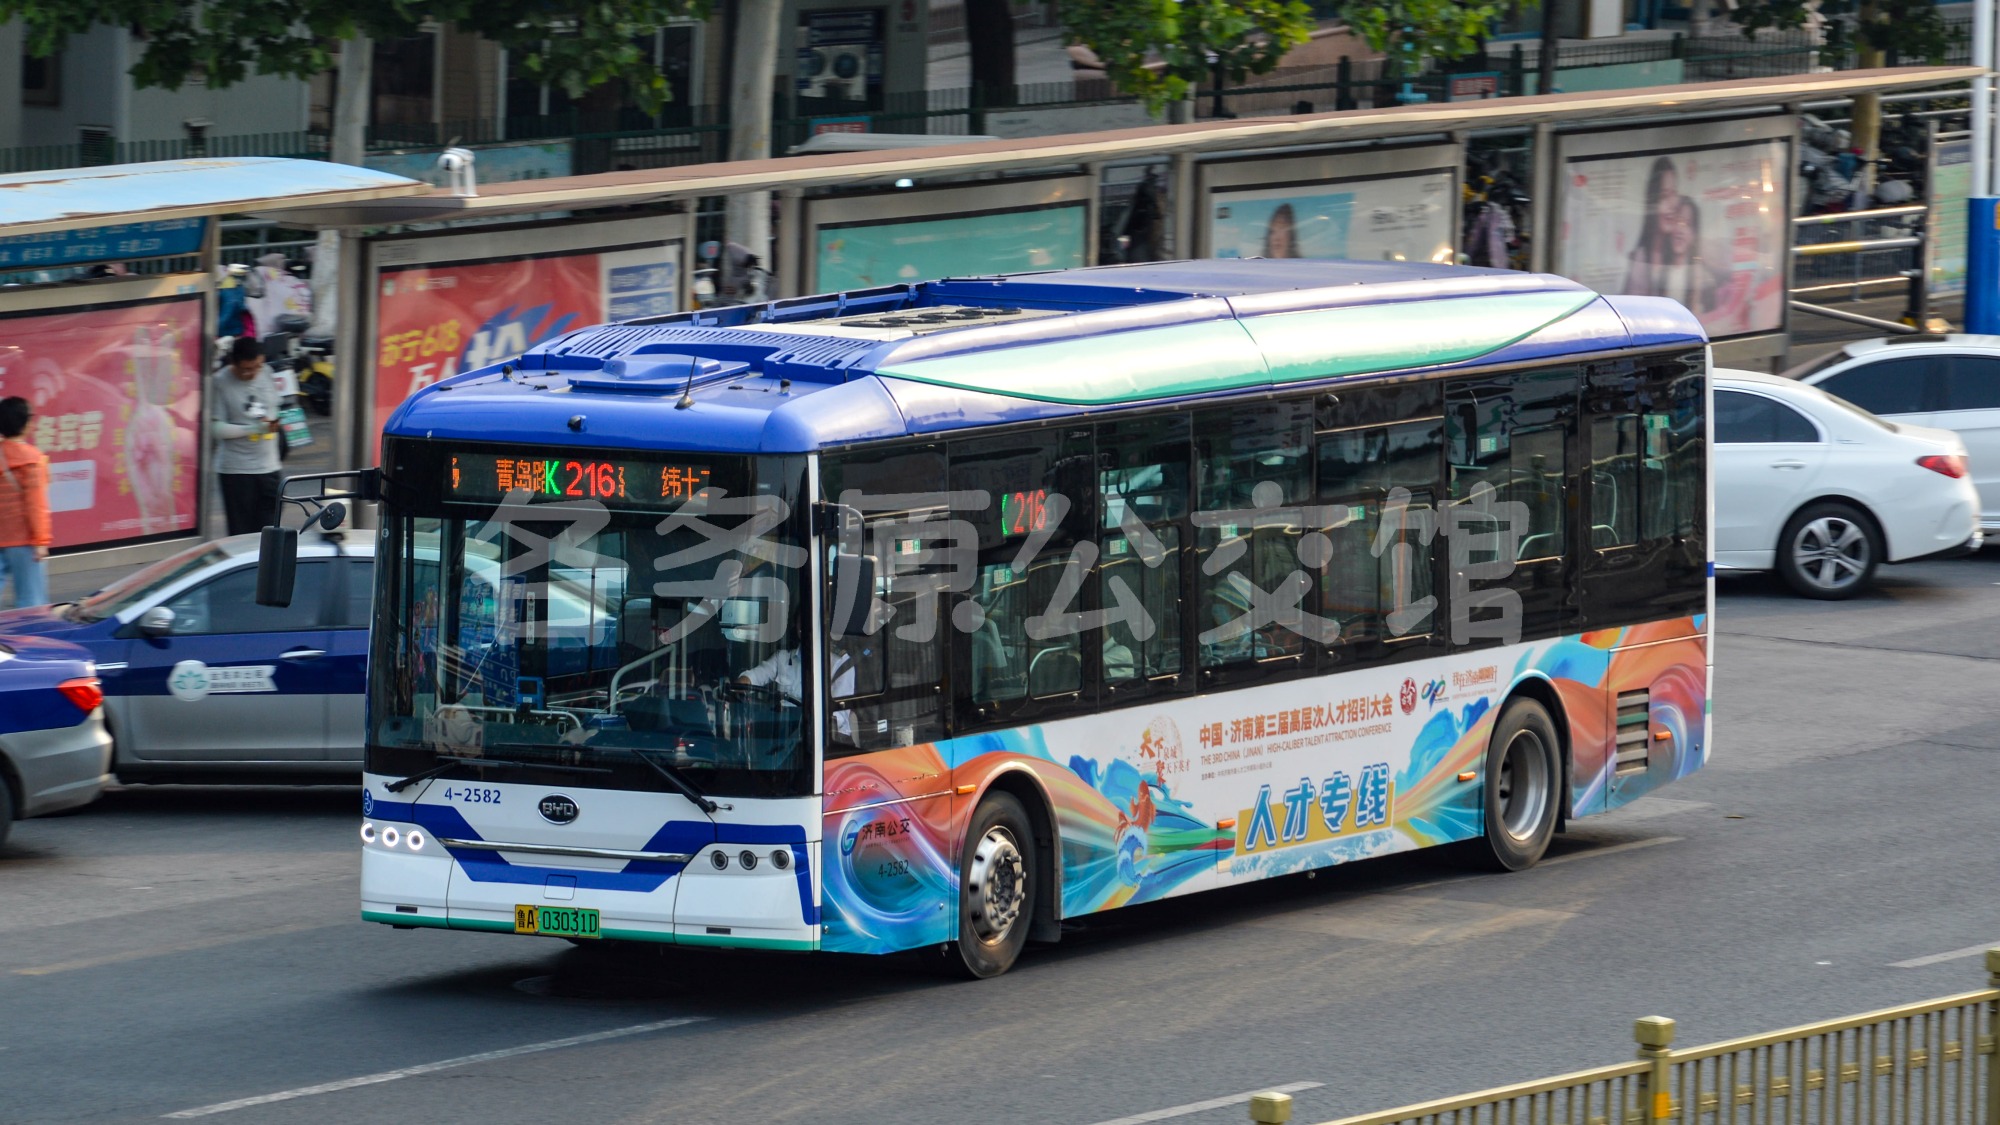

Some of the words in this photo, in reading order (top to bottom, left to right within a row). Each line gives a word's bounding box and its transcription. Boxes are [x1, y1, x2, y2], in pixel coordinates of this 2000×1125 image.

[566, 462, 616, 498] 216
[1013, 489, 1047, 534] 216
[1201, 755, 1212, 766] THE
[1212, 752, 1223, 764] 3RD
[1223, 749, 1241, 762] CHINA
[1267, 738, 1304, 754] HIGH-CALIBER
[1304, 734, 1324, 747] TALENT
[1324, 728, 1357, 743] ATTRACTION
[1357, 722, 1392, 738] CONFERENCE
[443, 787, 501, 804] 4-2582
[541, 801, 575, 817] BYD
[1244, 762, 1390, 851] 人才专线
[861, 818, 911, 841] 济南公交
[878, 859, 909, 878] 4-2582
